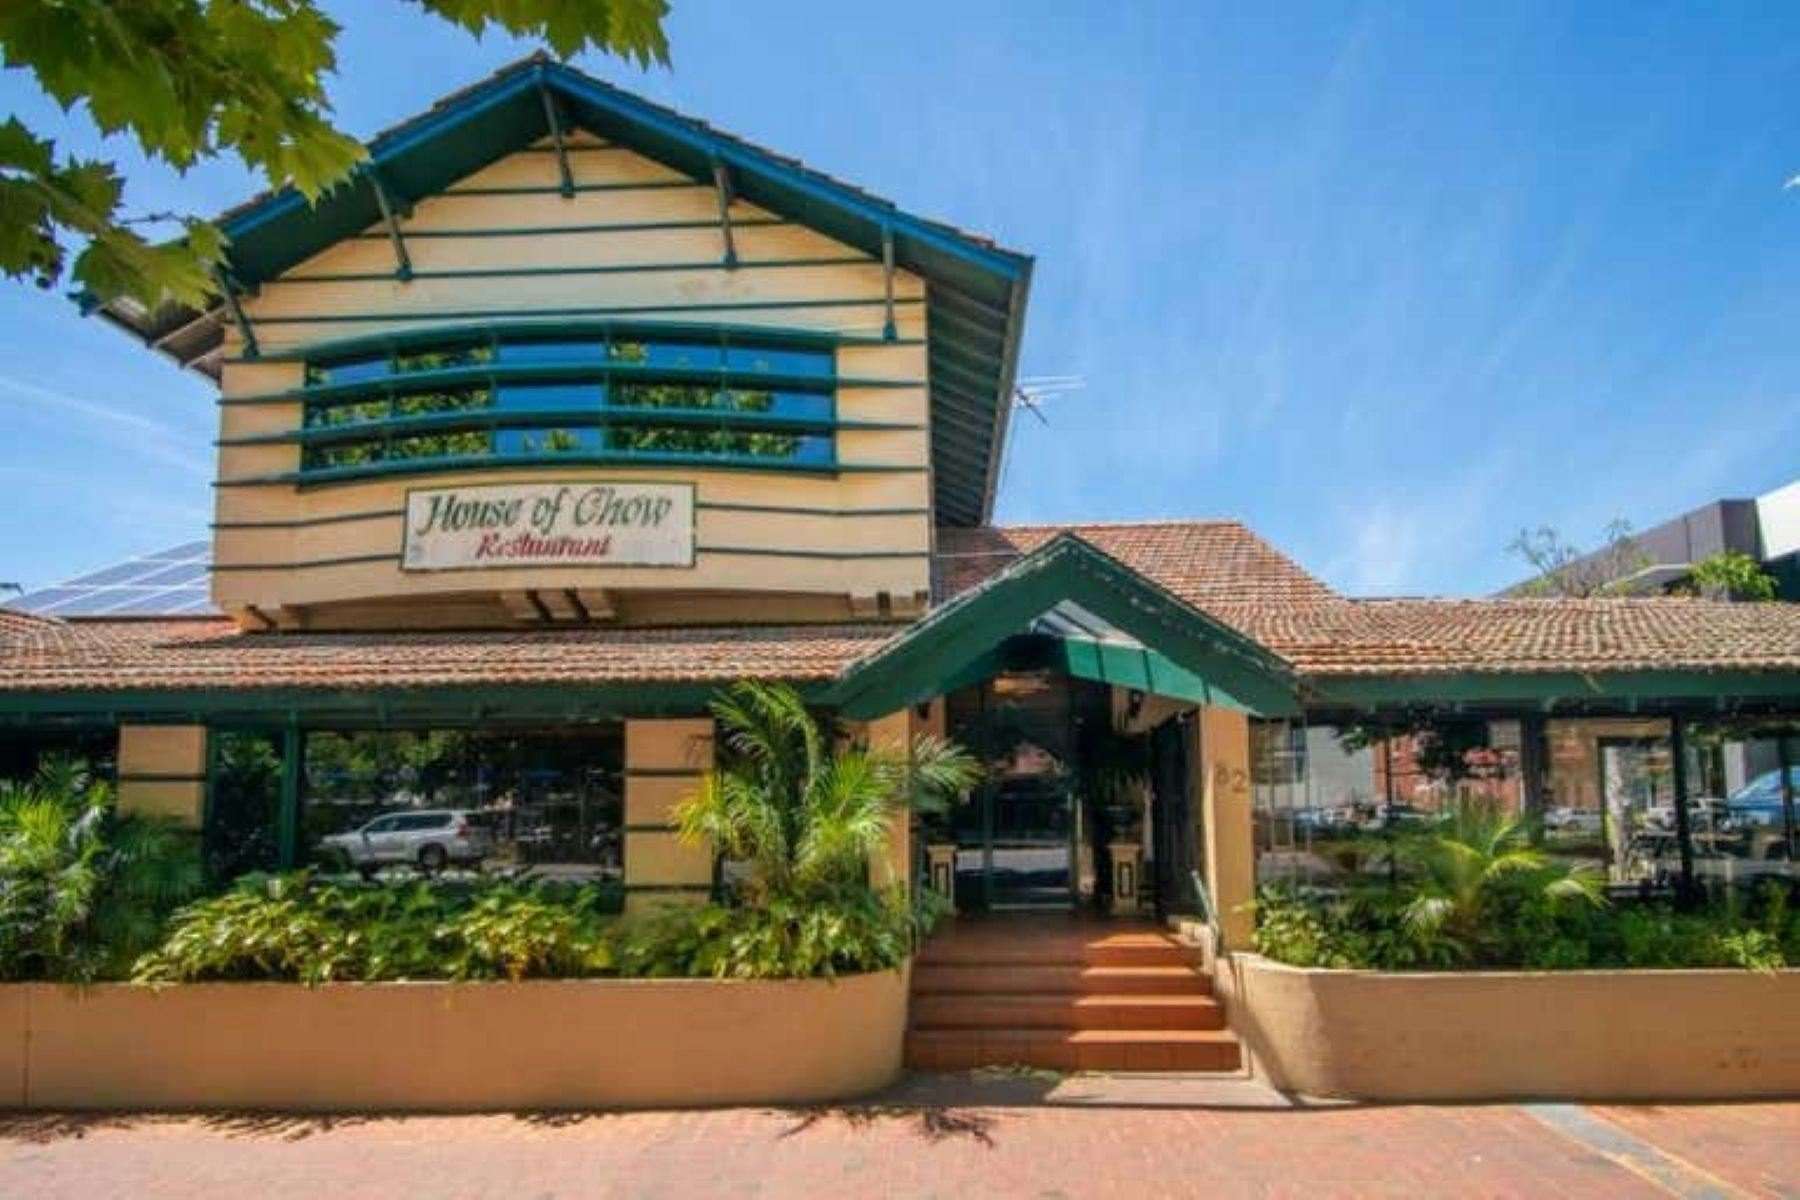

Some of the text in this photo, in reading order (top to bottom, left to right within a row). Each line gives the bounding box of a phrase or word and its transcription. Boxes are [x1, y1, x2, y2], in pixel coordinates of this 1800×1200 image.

[414, 487, 673, 536] House of Chow
[475, 533, 612, 560] Restaurant
